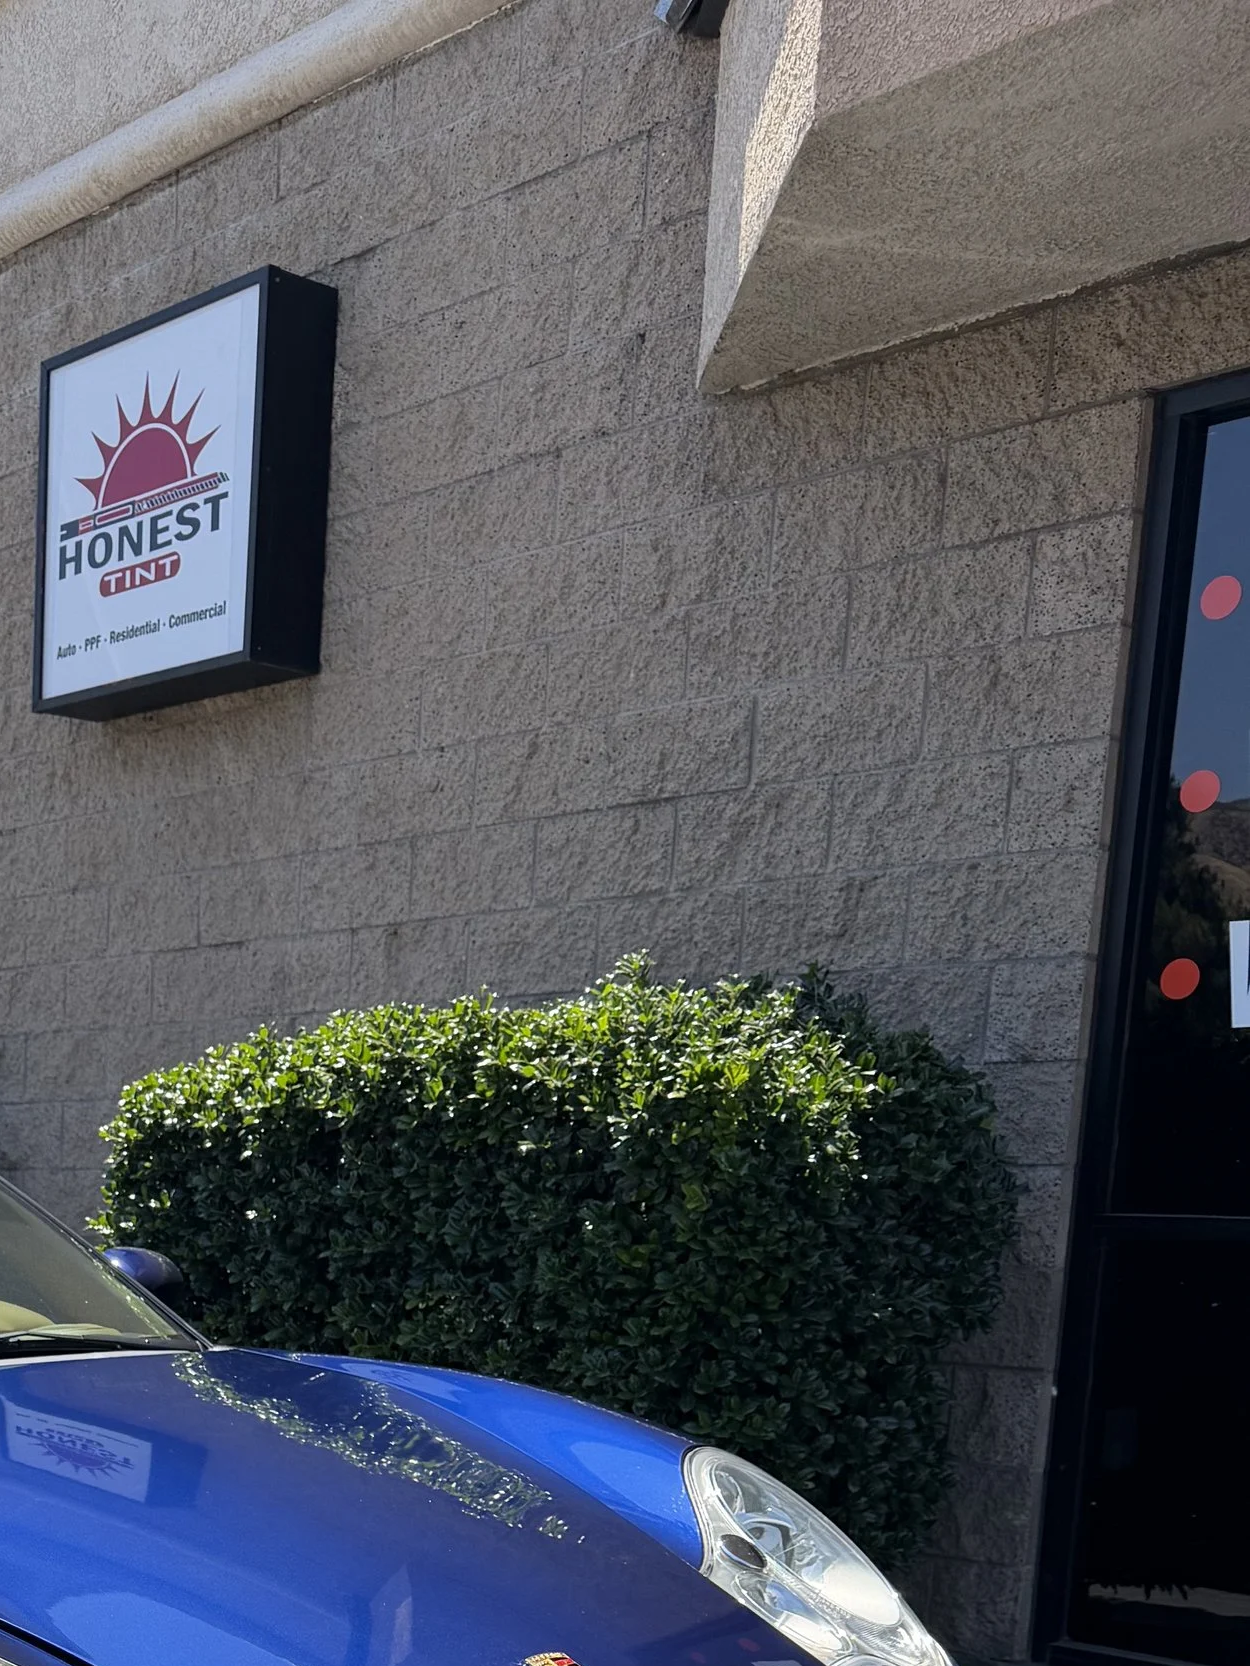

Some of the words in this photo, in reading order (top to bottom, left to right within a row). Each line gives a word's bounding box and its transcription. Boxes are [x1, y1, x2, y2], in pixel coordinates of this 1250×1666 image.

[58, 491, 229, 580] HONEST
[104, 554, 178, 593] TINT
[56, 645, 77, 660] Auto
[84, 634, 102, 652] PPF
[109, 618, 161, 645] Residential
[168, 600, 227, 629] Commercial
